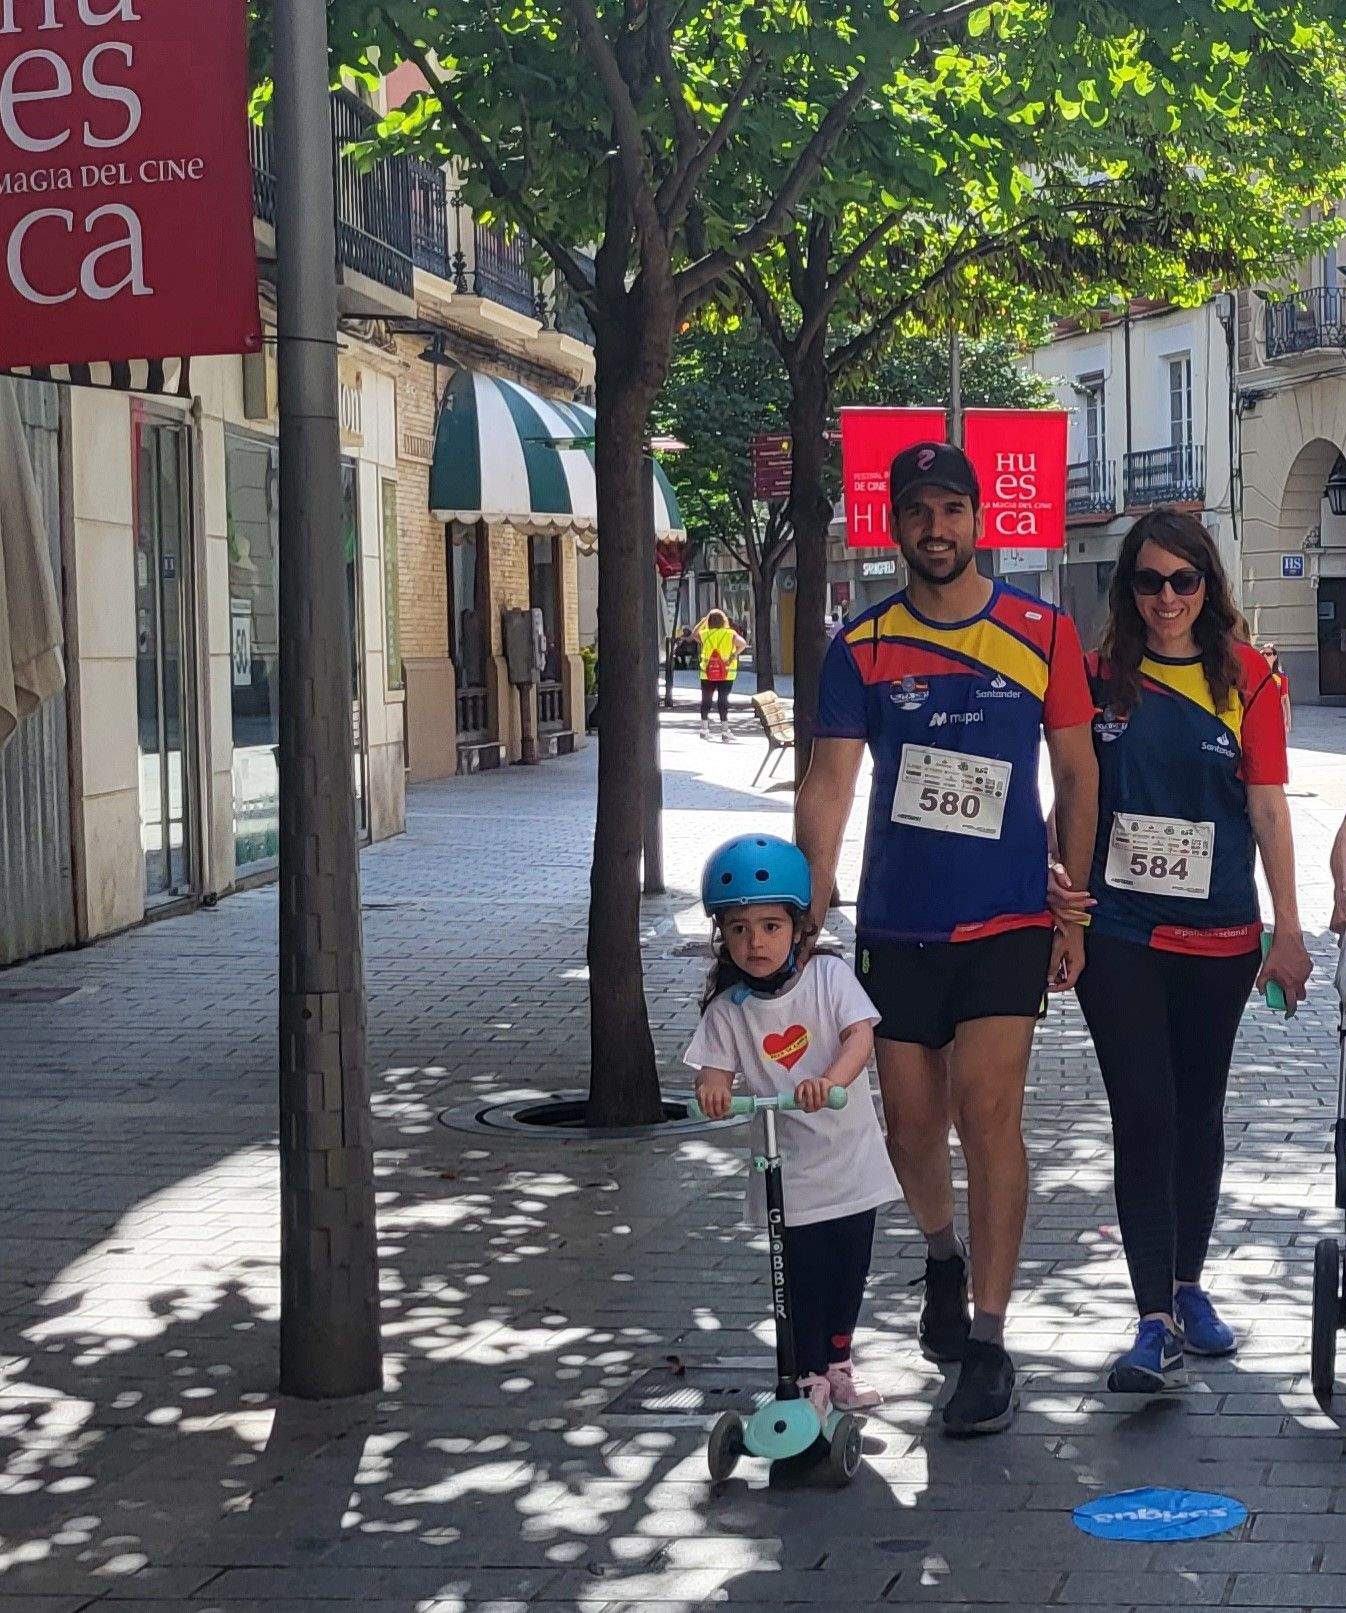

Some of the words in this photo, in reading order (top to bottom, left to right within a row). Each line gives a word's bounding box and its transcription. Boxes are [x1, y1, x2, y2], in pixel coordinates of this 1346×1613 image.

[0, 42, 142, 152] es
[7, 203, 153, 304] ca
[995, 474, 1037, 500] es
[996, 511, 1038, 534] ca
[976, 689, 1022, 699] Santander
[950, 709, 984, 726] mupol
[919, 787, 981, 818] 580
[1130, 853, 1189, 880] 584
[768, 1208, 787, 1319] GLOBBER
